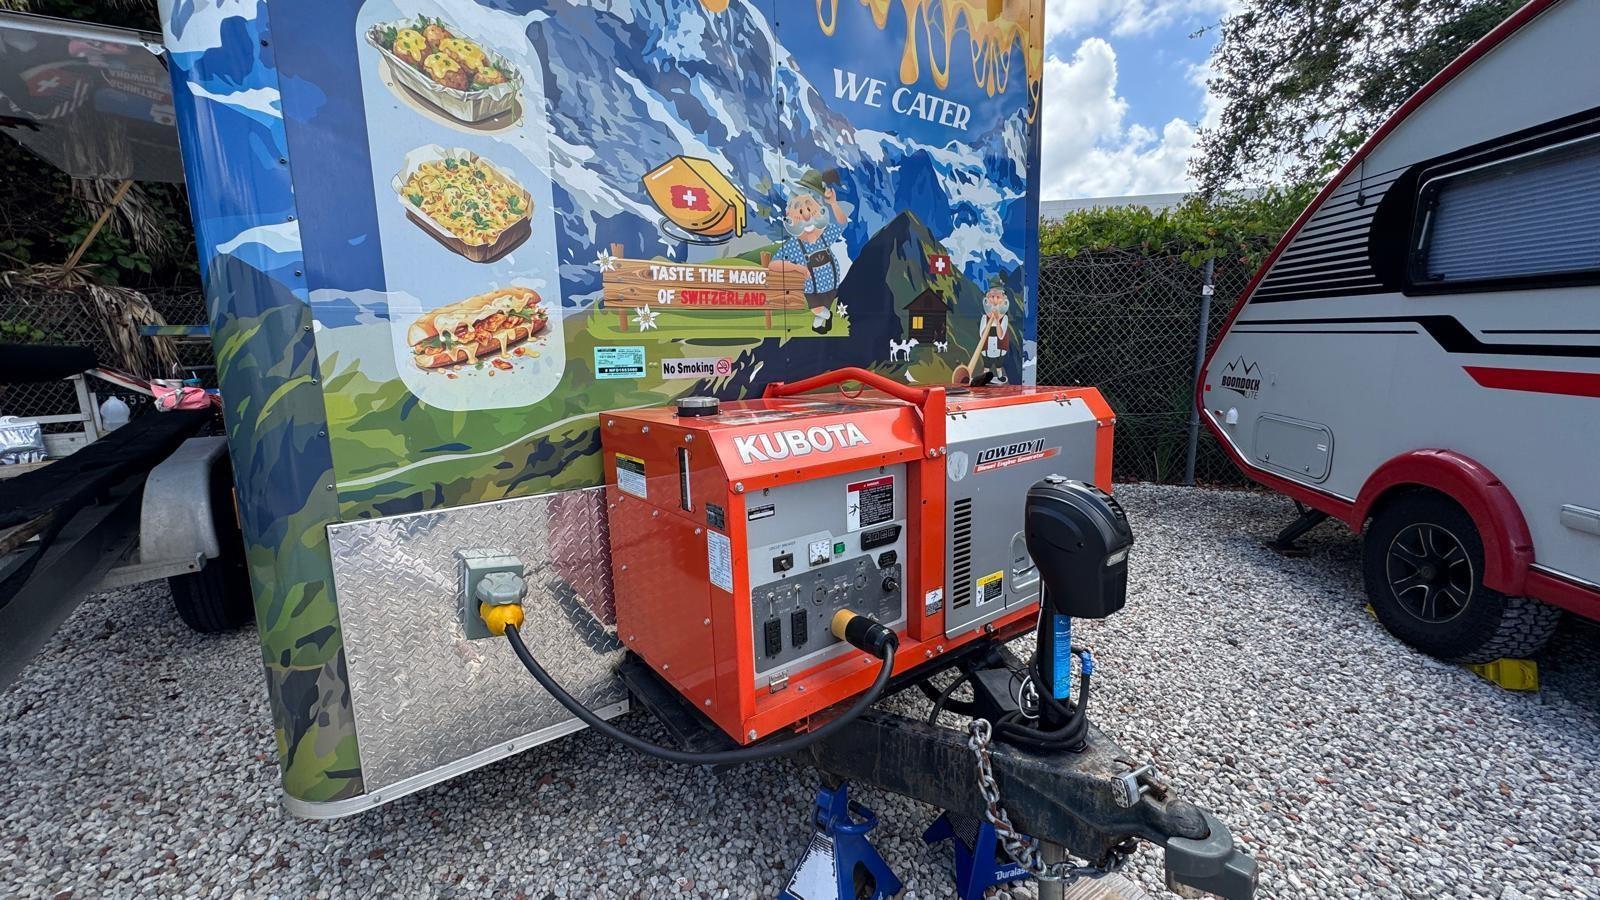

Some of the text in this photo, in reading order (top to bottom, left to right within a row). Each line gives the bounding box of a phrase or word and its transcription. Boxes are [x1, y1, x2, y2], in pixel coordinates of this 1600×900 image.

[833, 68, 971, 131] WE CATER
[650, 265, 768, 285] TASTE THE MAGIC
[657, 289, 767, 306] OF SWITZERLAND
[663, 361, 714, 376] No Smoking
[1222, 376, 1260, 391] BOONDOCK
[733, 422, 872, 465] KUBOTA
[976, 441, 1035, 466] LOWBOY
[976, 452, 1044, 473] Diesel Engine Generator
[994, 867, 1026, 881] Duralas
